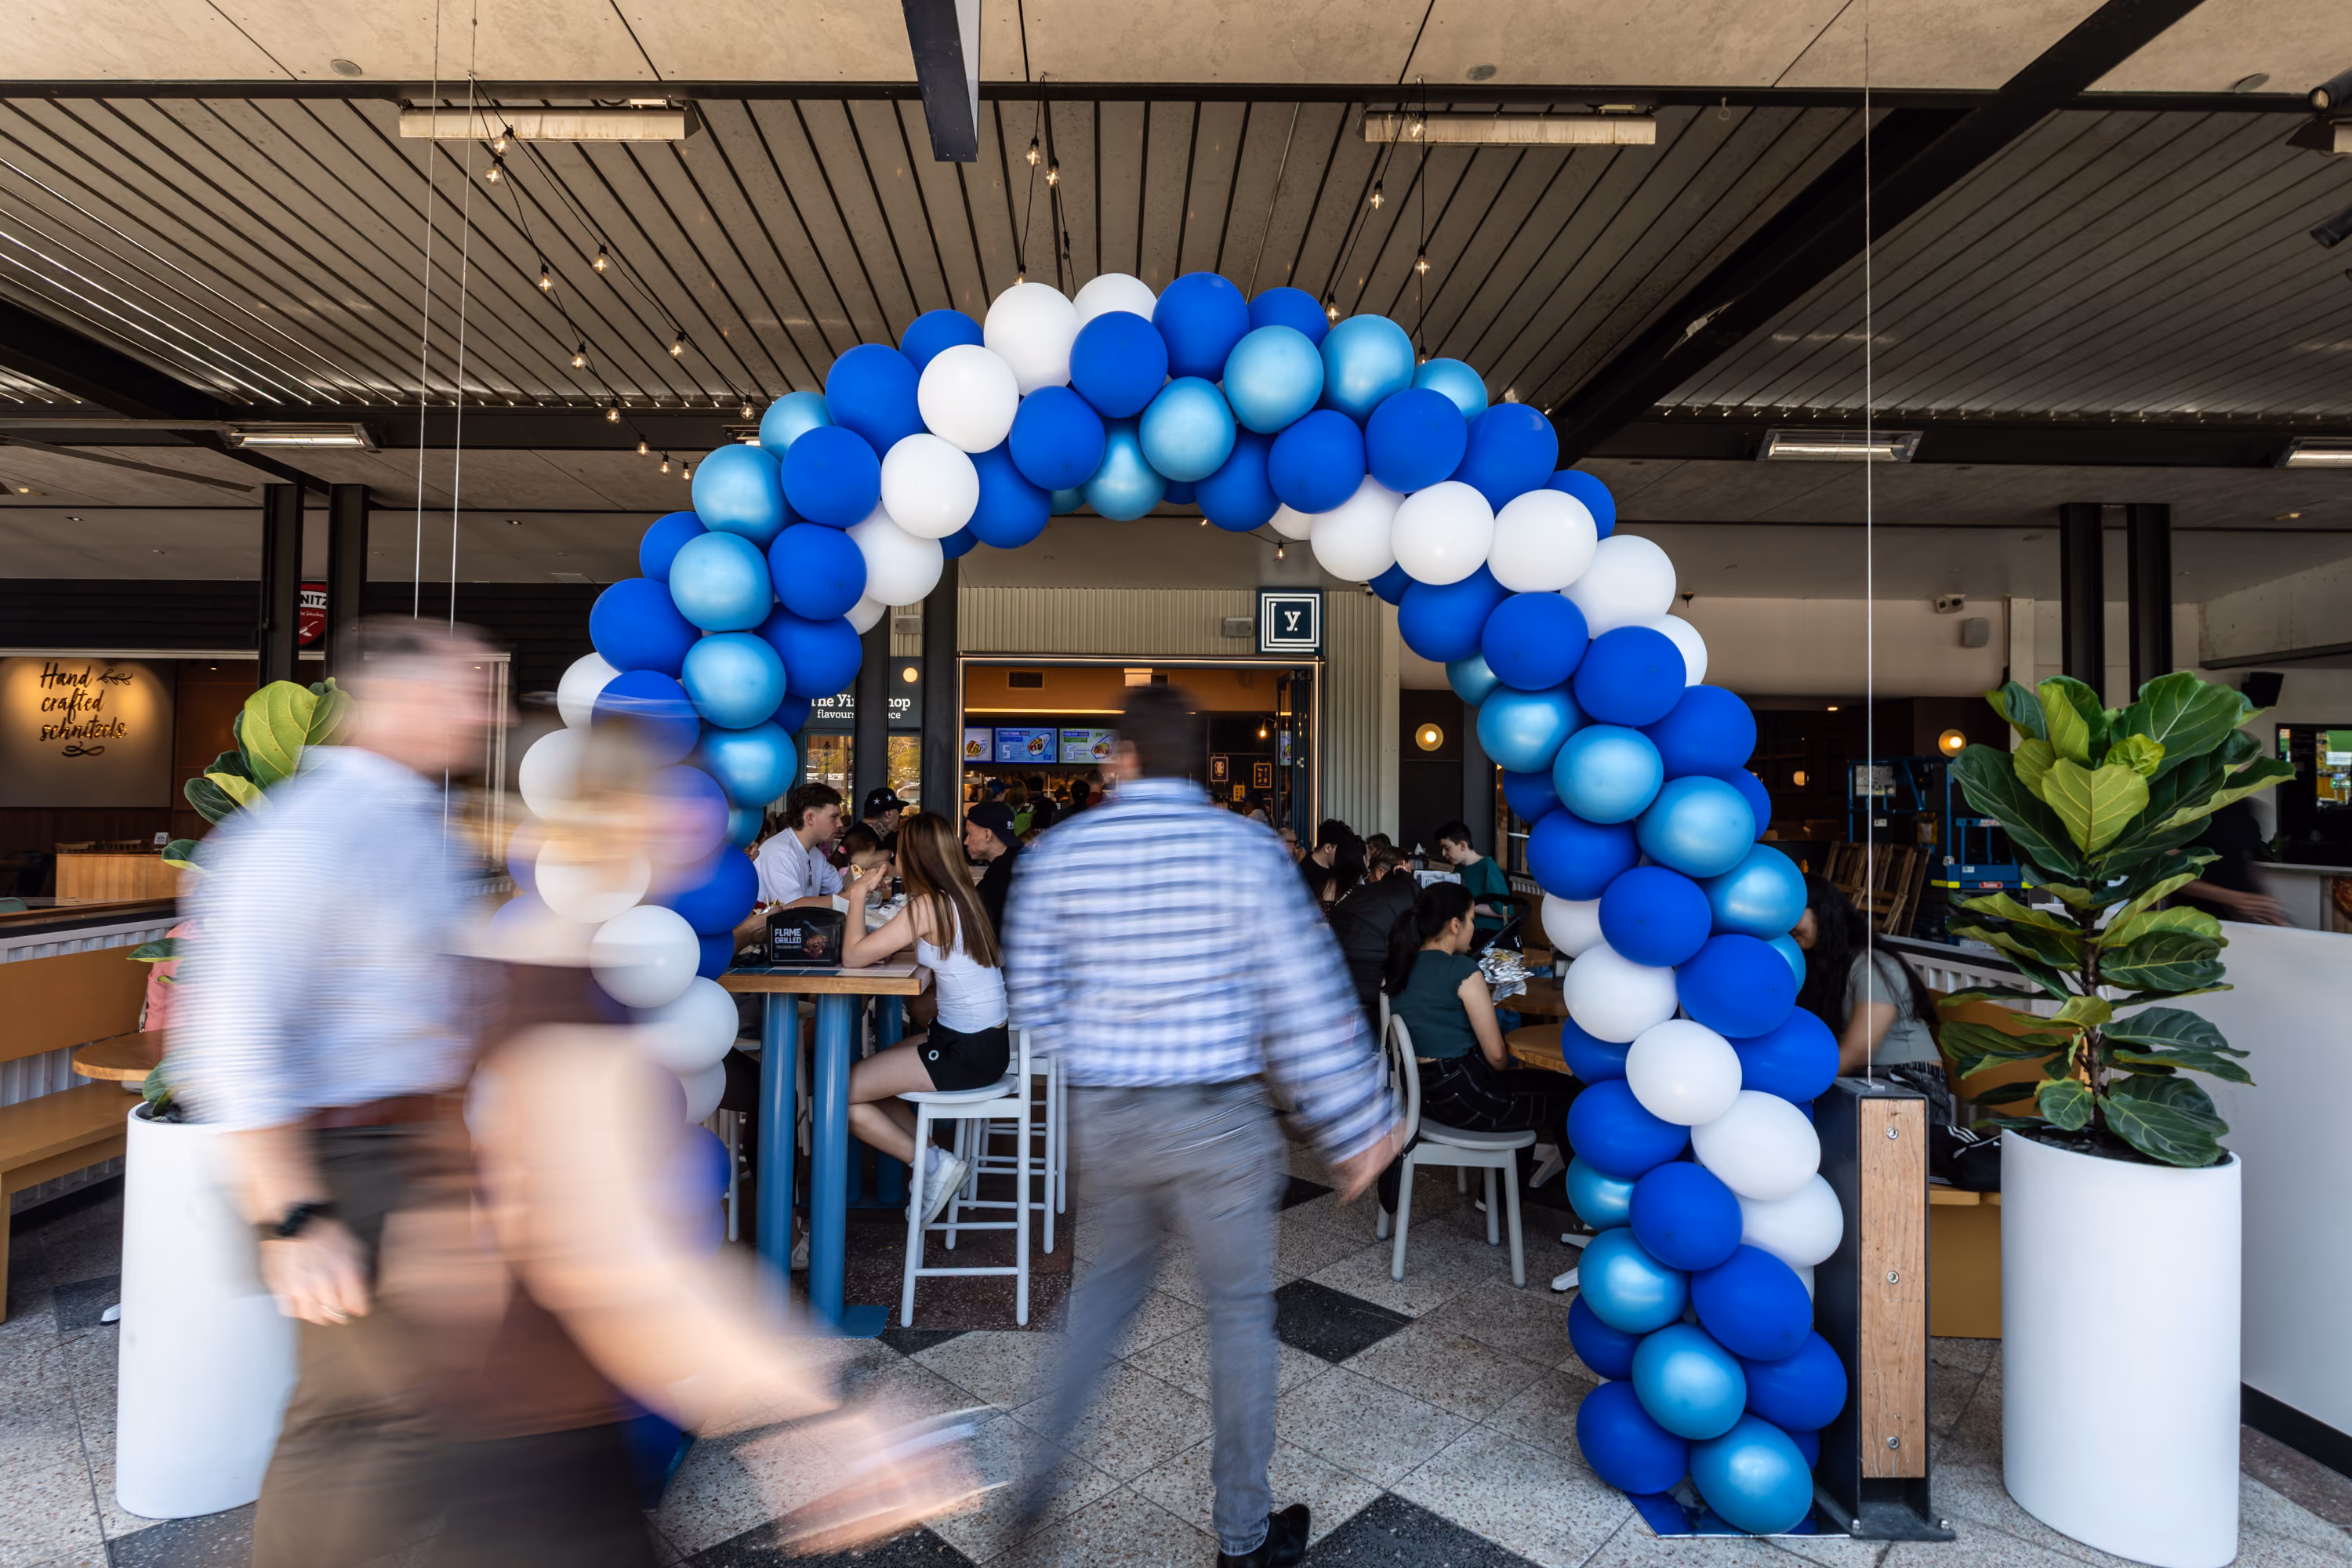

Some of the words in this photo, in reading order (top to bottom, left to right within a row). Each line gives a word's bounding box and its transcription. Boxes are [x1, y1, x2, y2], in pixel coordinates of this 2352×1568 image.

[40, 662, 93, 689] Hand
[41, 688, 106, 724] crafted
[775, 928, 801, 937] FLAME
